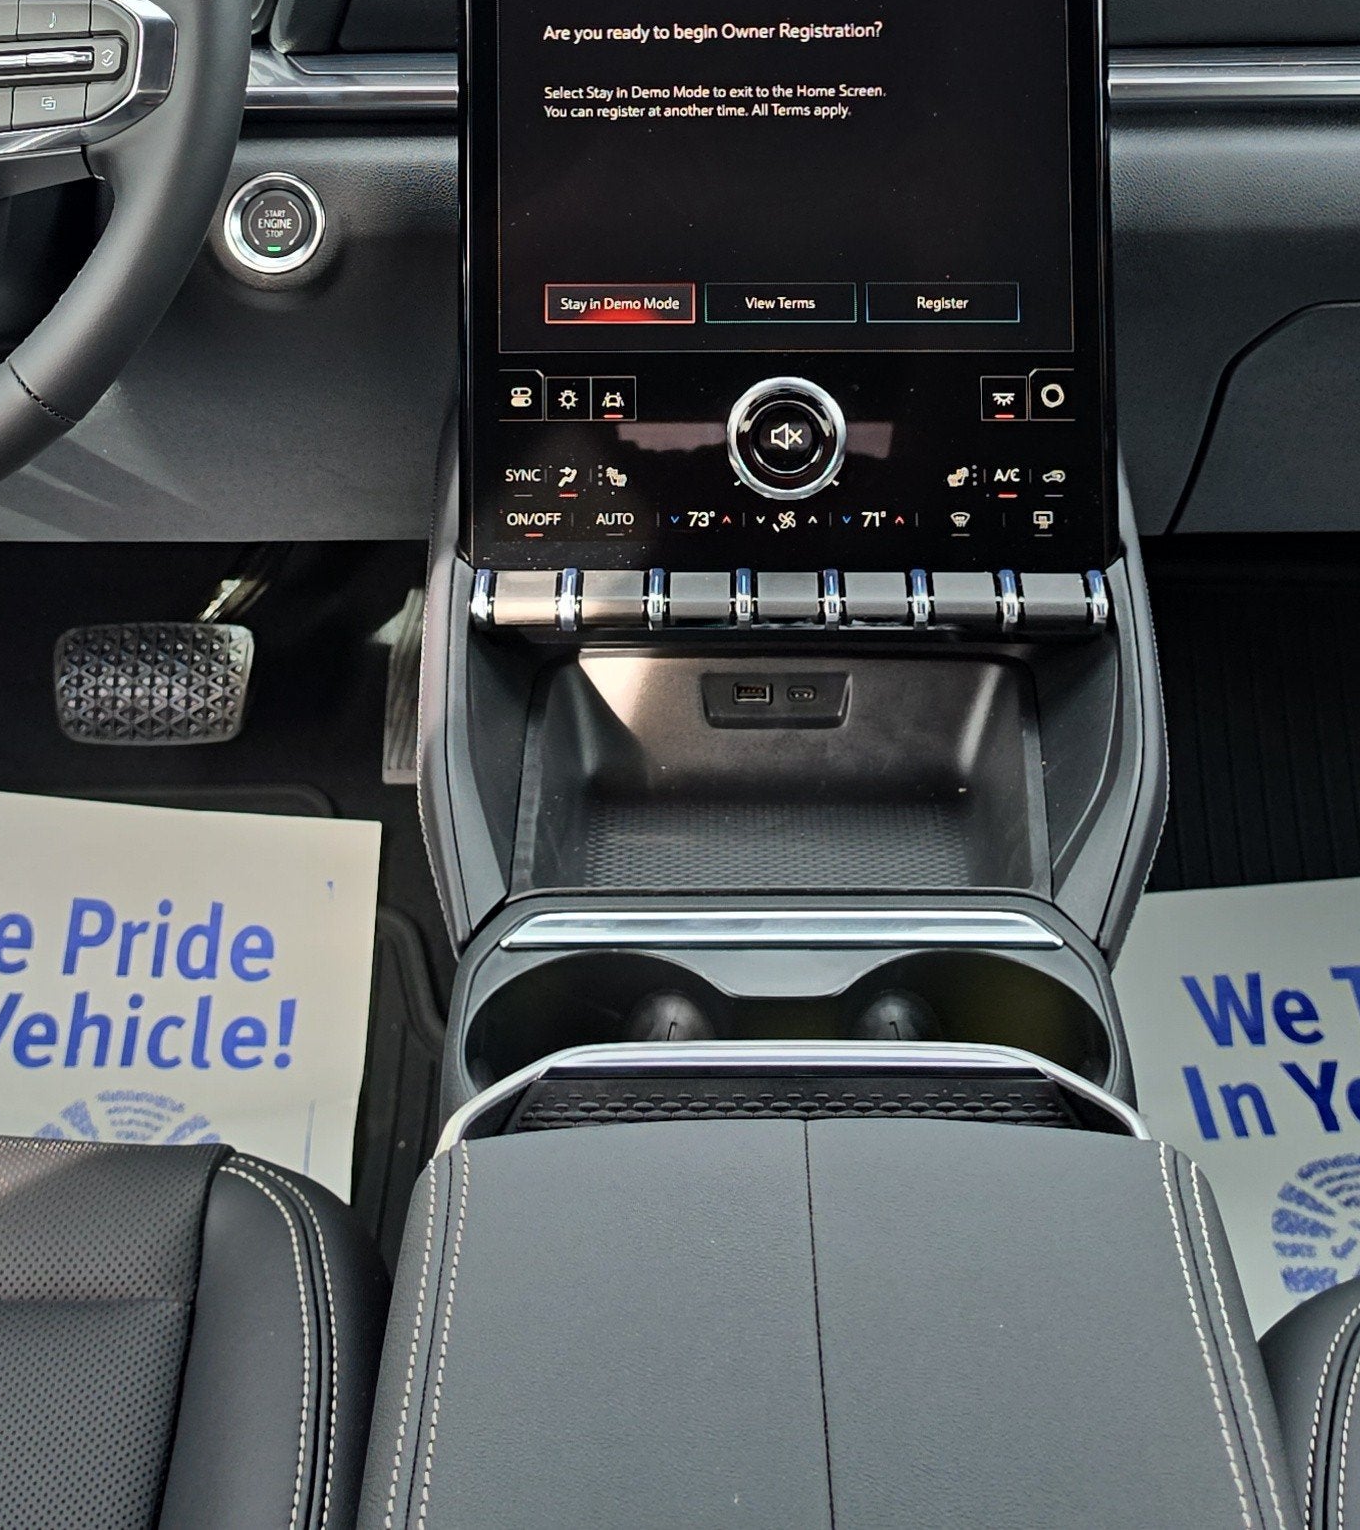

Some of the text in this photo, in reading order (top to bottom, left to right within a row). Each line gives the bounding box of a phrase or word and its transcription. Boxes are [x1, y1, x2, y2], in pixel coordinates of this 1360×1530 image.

[543, 21, 883, 44] Are you ready to begin Owner Registration?
[544, 83, 886, 102] Select Stay in Demo Mode to exit to the Home Screen.
[544, 103, 851, 121] You can register at another time. All Terms apply.
[264, 209, 286, 218] START
[258, 218, 293, 229] ENGINE
[265, 230, 284, 238] STOP
[560, 296, 680, 314] Stay in Demo Mode
[745, 296, 816, 310] View Terms
[917, 295, 969, 313] Register
[505, 468, 542, 482] SYNC
[993, 467, 1021, 482] A/C
[506, 512, 562, 526] ON/OFF
[595, 512, 635, 526] AUTO
[63, 898, 275, 983] Pride
[1183, 973, 1325, 1048] We
[1183, 1066, 1276, 1142] In
